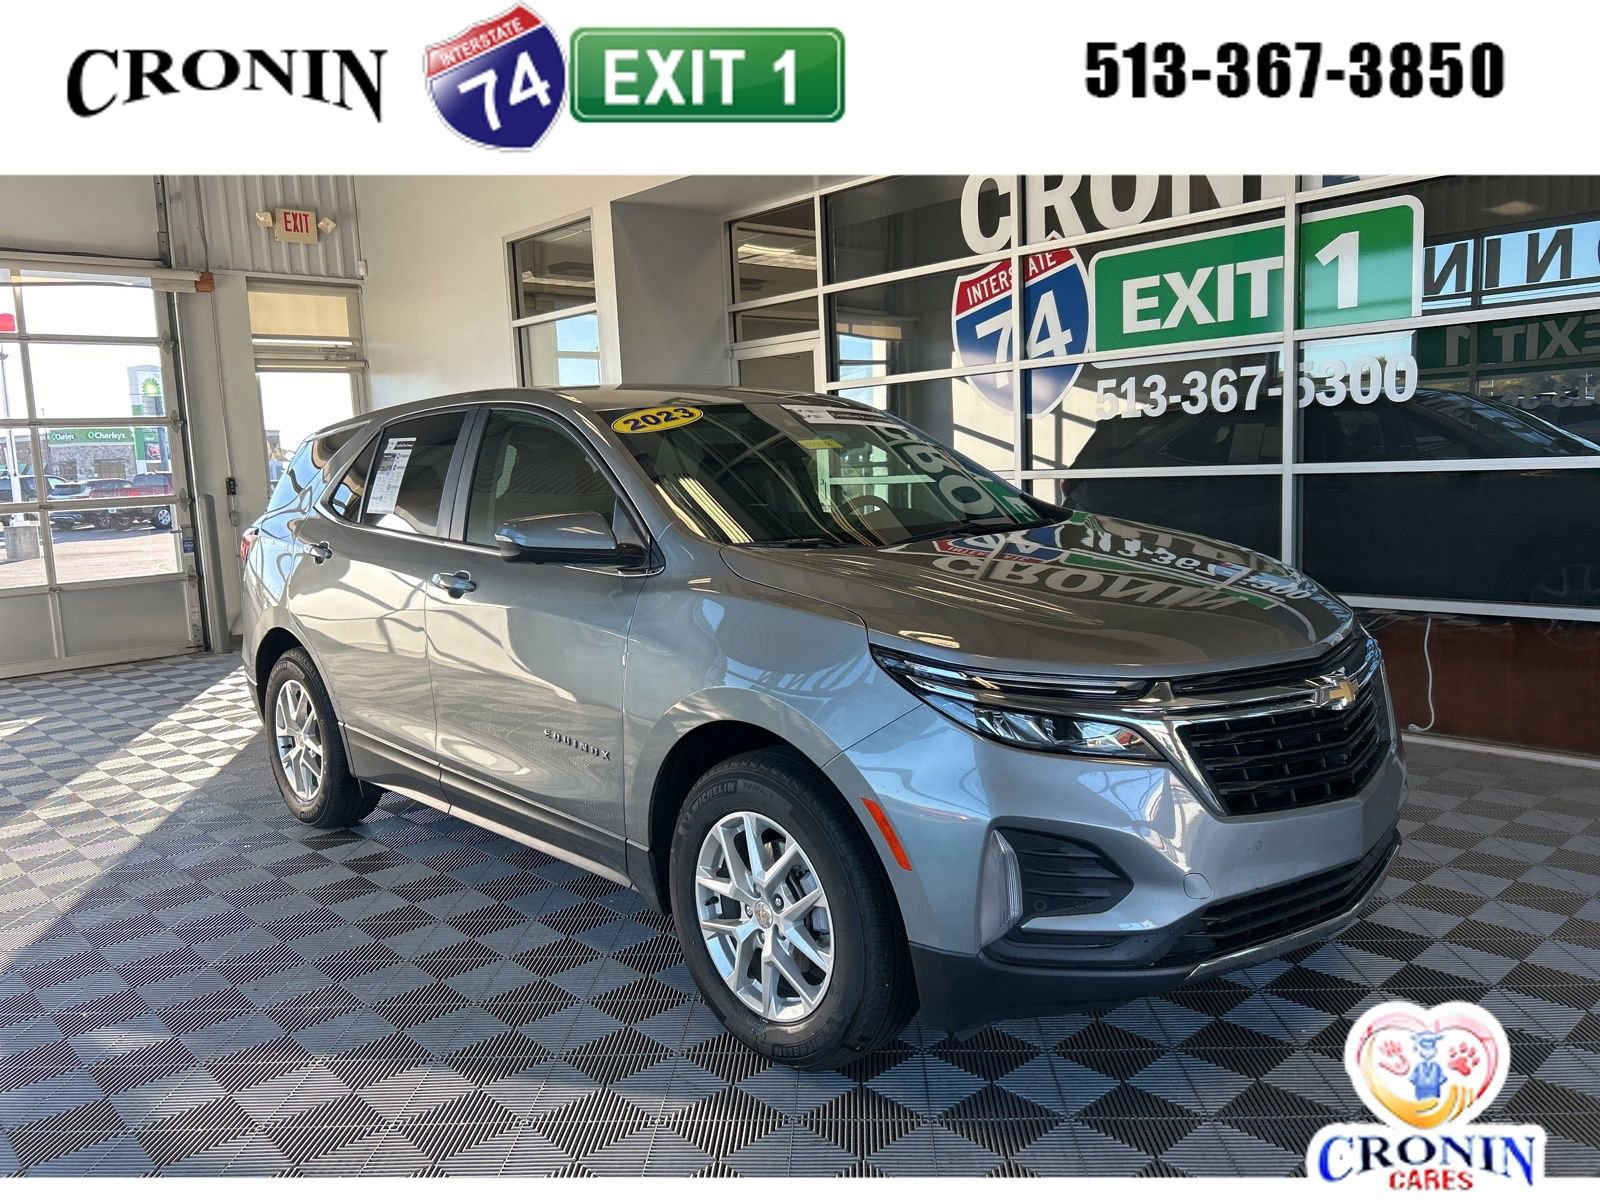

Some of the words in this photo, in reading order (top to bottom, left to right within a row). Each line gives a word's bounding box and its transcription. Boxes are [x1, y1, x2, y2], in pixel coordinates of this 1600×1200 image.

[283, 211, 310, 234] EXIT
[1122, 255, 1284, 335] EXIT
[1314, 230, 1360, 310] 1
[974, 289, 1073, 390] 74
[623, 408, 696, 431] 2023
[543, 728, 611, 762] EQUINOX
